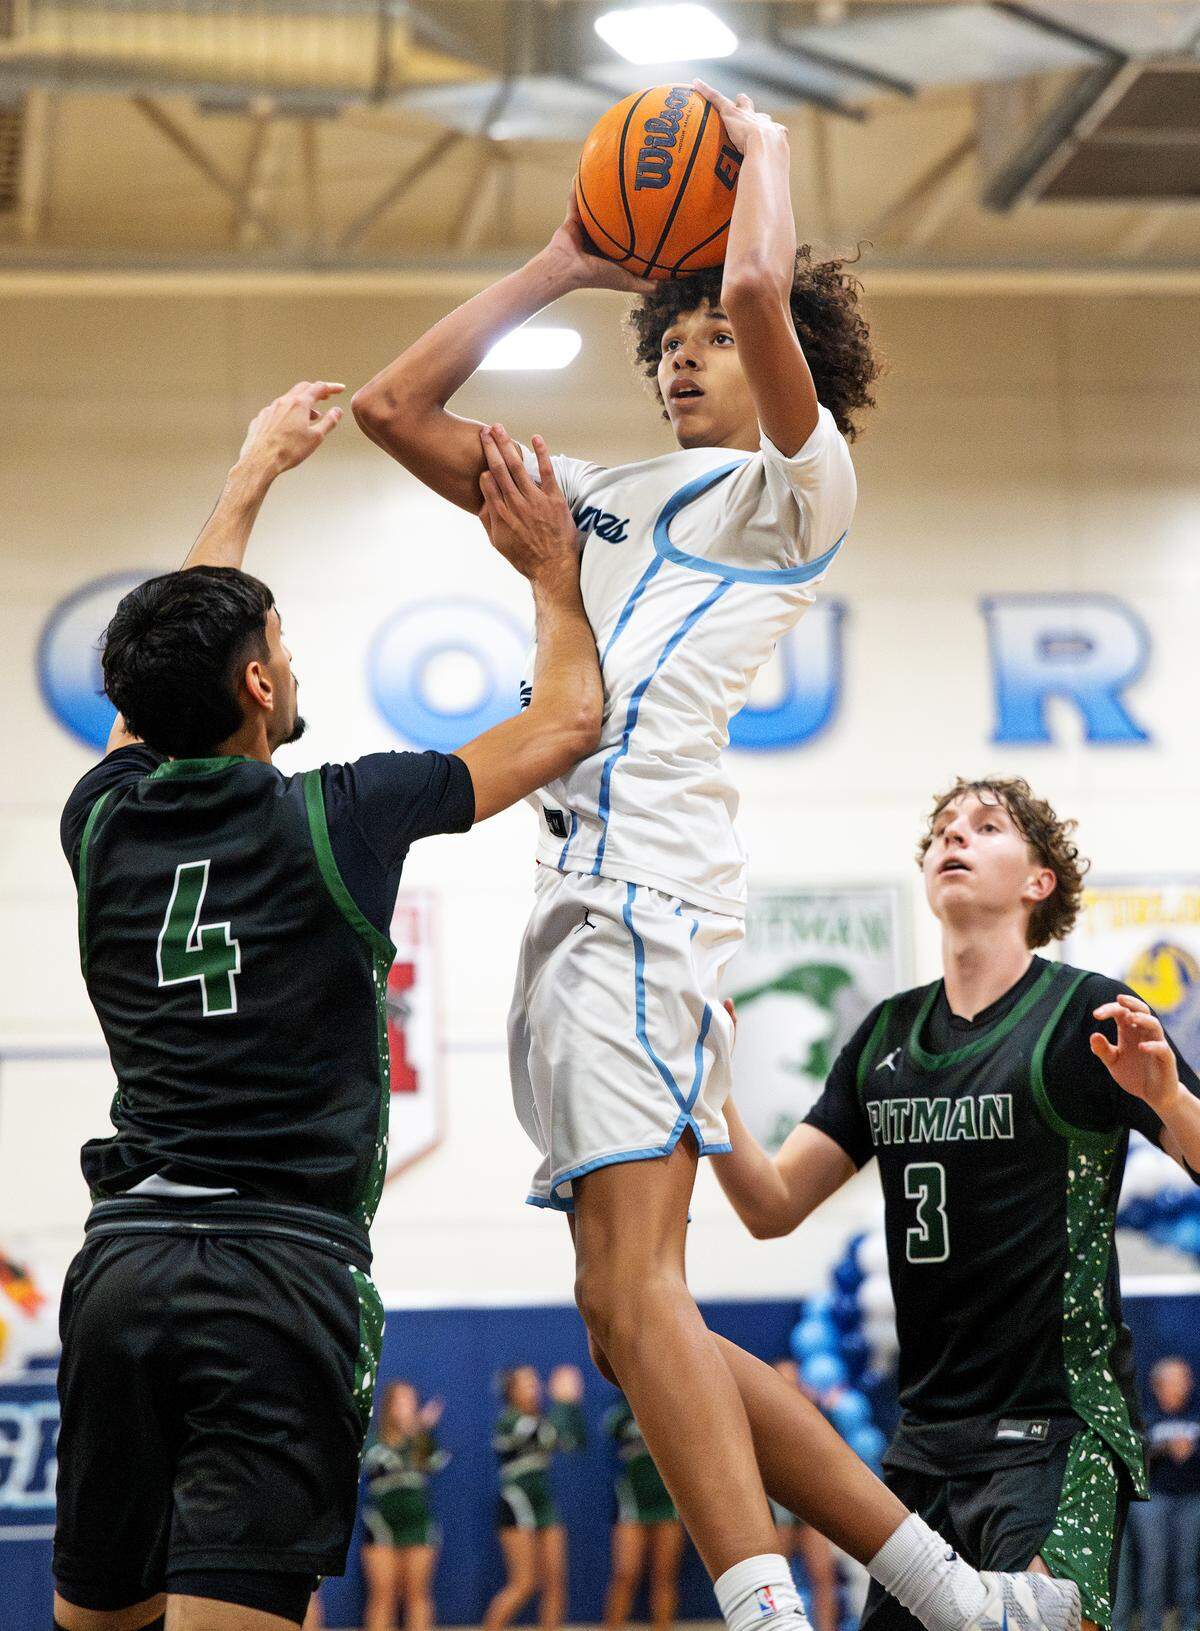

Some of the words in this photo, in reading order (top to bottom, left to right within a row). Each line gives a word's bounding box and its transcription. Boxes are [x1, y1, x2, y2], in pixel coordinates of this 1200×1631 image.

[635, 87, 692, 191] Wilson
[156, 858, 242, 1017] 4
[866, 1093, 1015, 1147] PITMAN
[904, 1161, 951, 1265] 3
